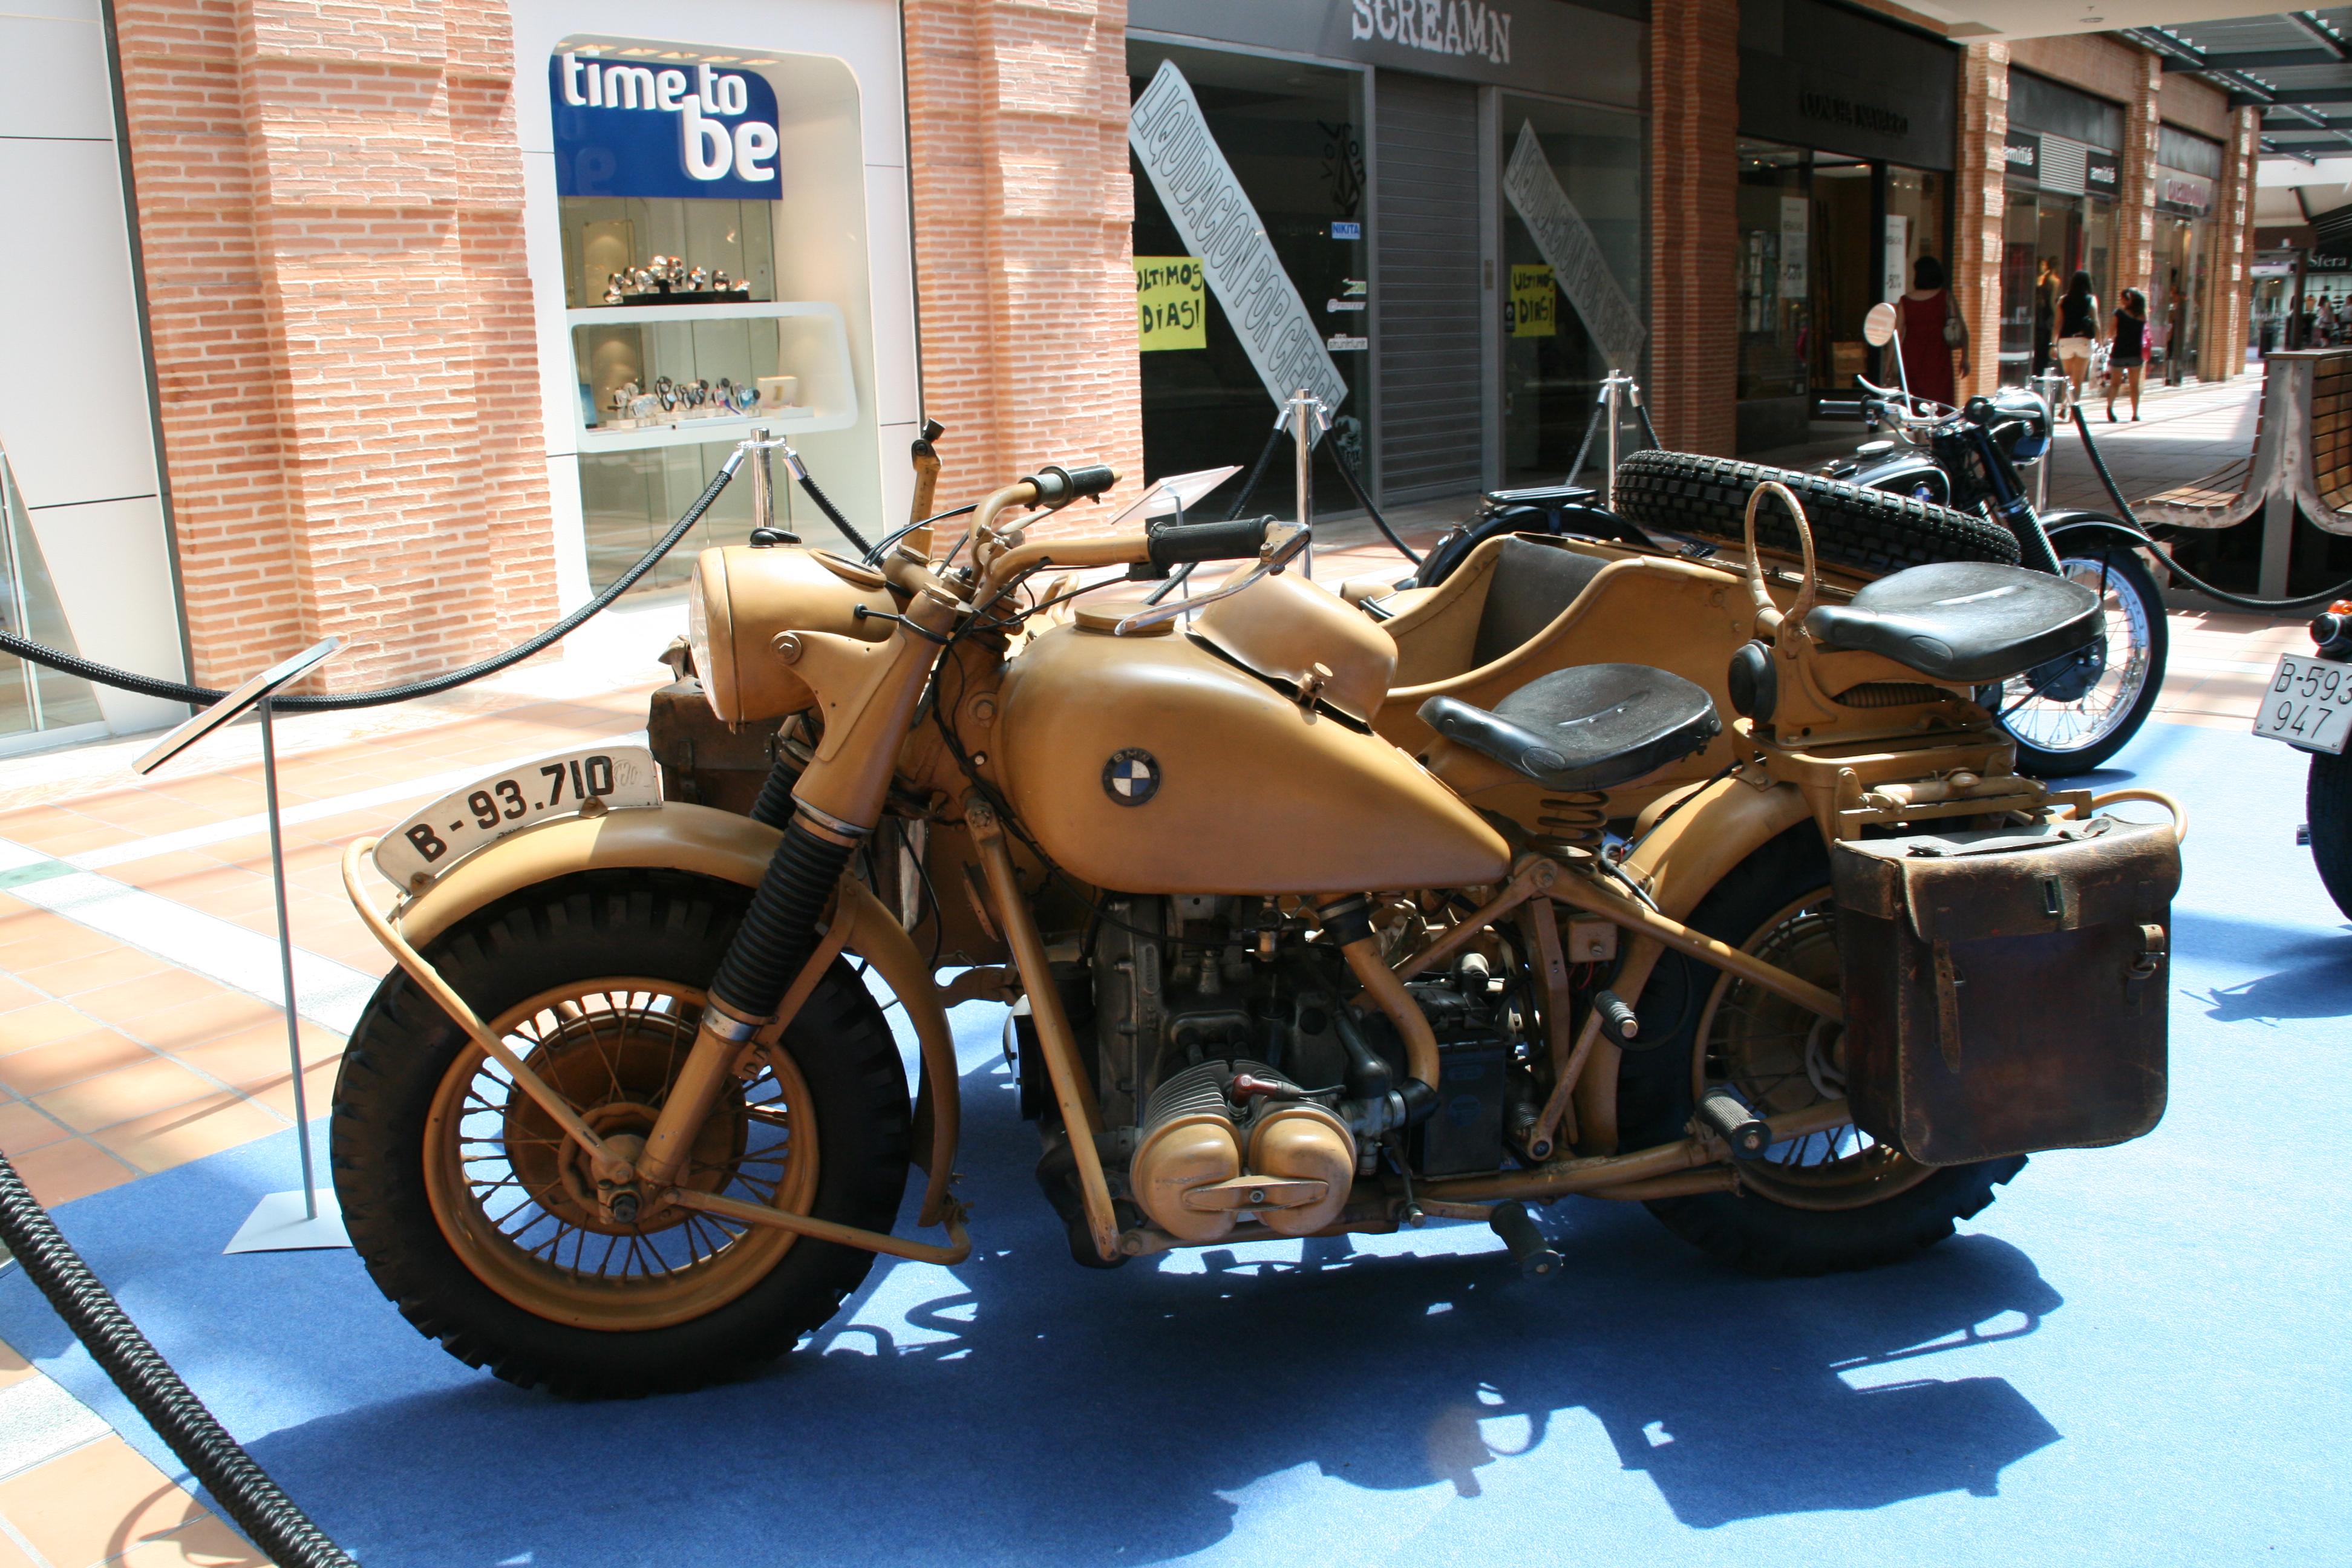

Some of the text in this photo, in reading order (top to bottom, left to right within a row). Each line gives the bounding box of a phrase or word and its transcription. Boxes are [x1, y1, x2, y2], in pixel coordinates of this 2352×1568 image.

[1352, 0, 1512, 64] SCREAMN
[563, 49, 748, 115] time to
[682, 94, 778, 181] be
[1131, 68, 1261, 292] LIQUIDACION
[1234, 253, 1291, 353] POR
[1332, 223, 1360, 234] NIKITA
[2308, 254, 2347, 267] Sfera
[2275, 663, 2352, 705] B-593
[2273, 701, 2334, 739] 947
[1114, 750, 1150, 763] BMW
